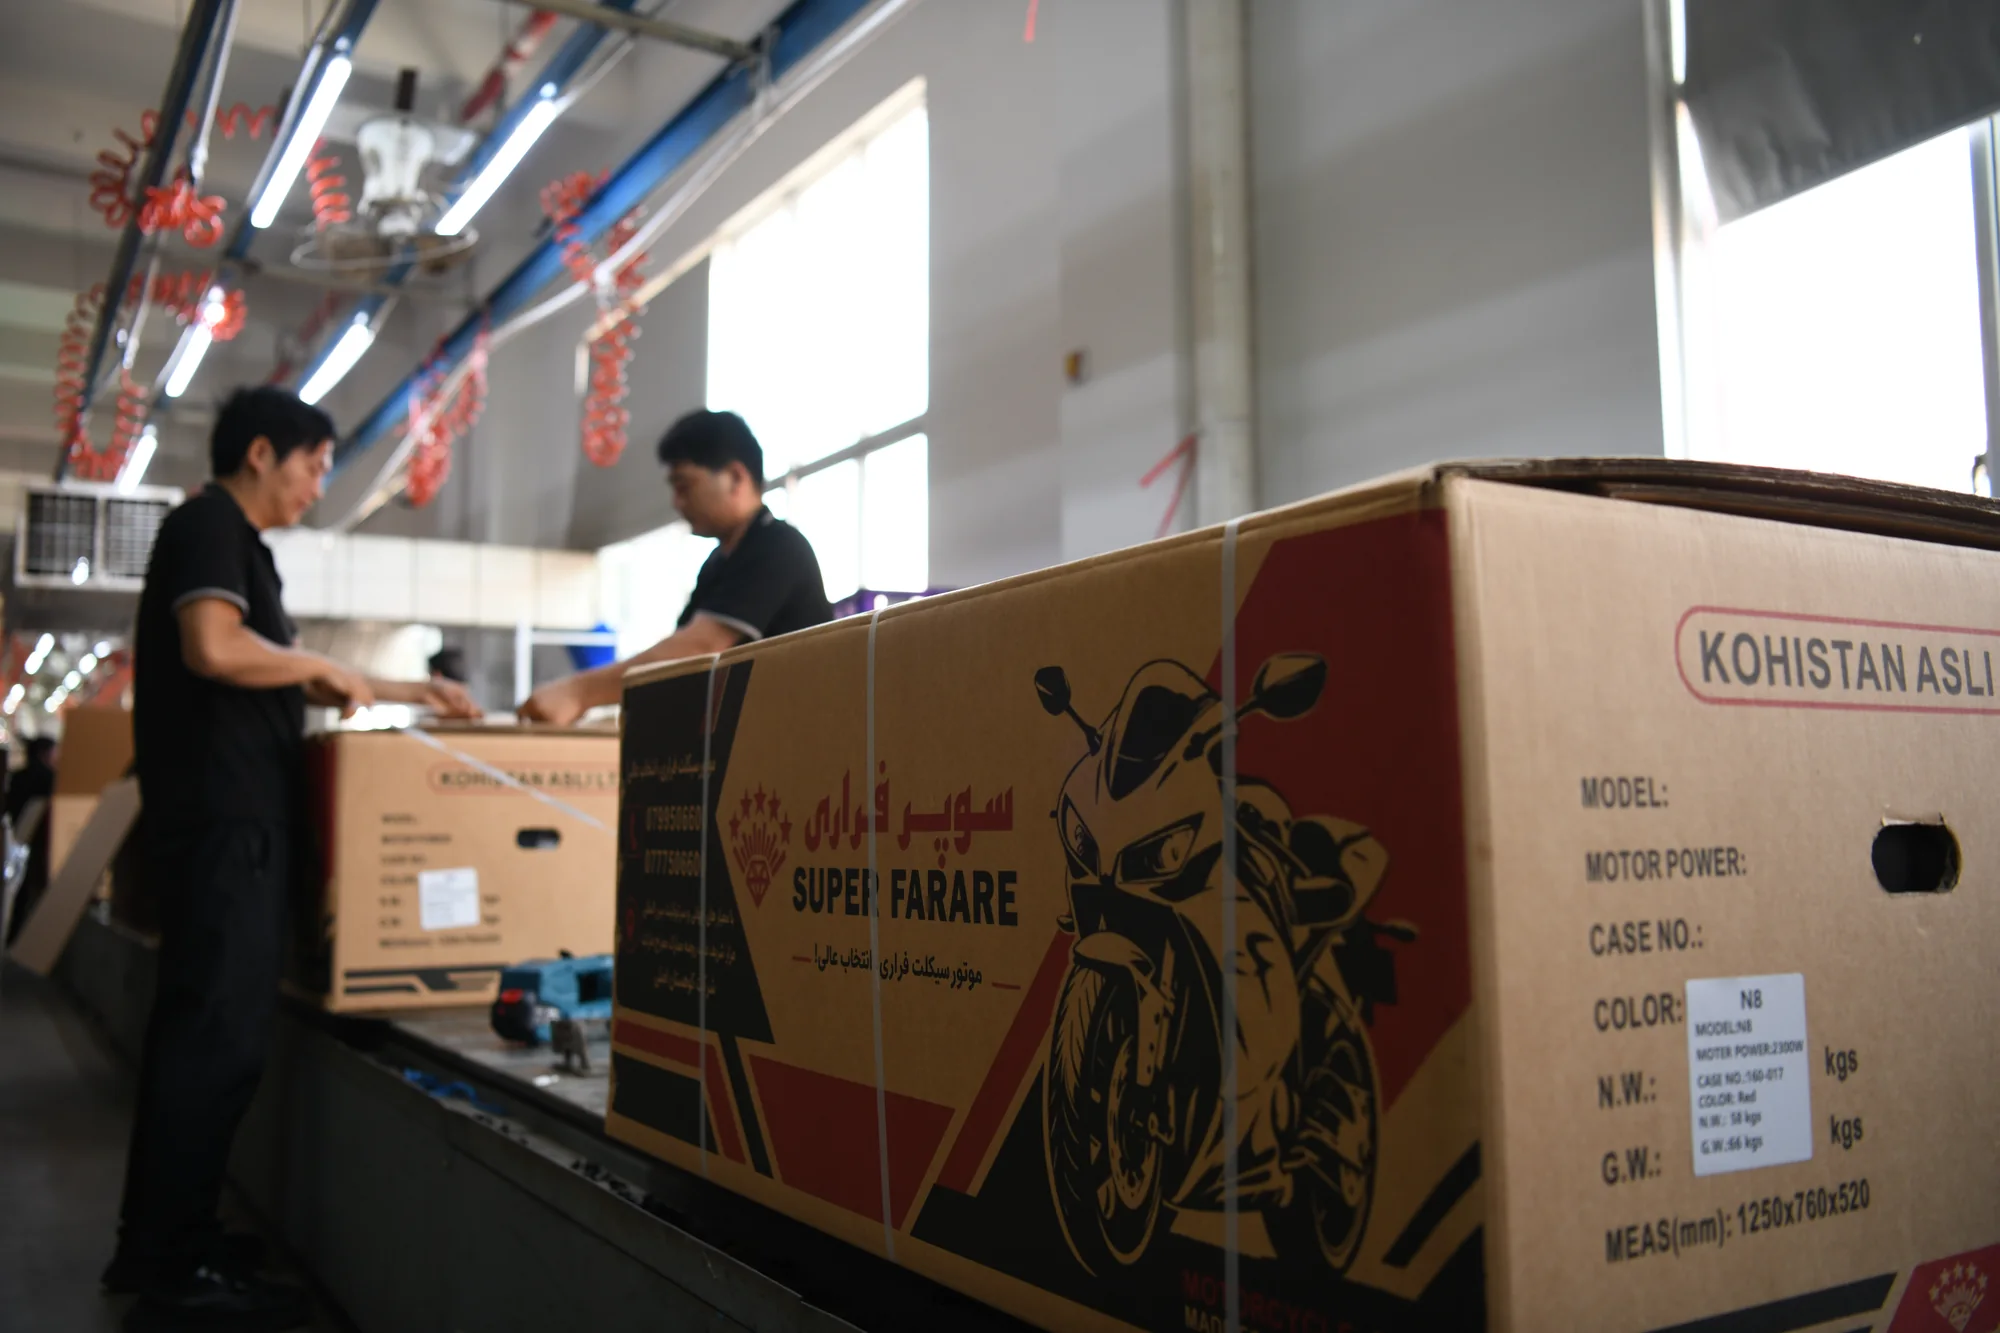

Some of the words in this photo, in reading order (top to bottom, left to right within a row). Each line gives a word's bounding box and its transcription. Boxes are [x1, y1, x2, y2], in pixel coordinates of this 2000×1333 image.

[1699, 631, 1907, 692] KOHISTAN
[1916, 646, 1995, 696] ASLI
[805, 760, 889, 853] فراری
[1581, 776, 1669, 808] MODEL:
[897, 784, 1013, 869] سوپر
[1586, 850, 1664, 883] MOTOR
[1667, 847, 1747, 878] POWER:
[891, 869, 1018, 927] FARARE
[1590, 920, 1652, 956] CASE
[1658, 917, 1703, 950] NO.:
[841, 948, 873, 973] انتخاب
[880, 952, 909, 980] فراری
[1594, 993, 1684, 1031] COLOR:
[1740, 989, 1763, 1010] N8
[1696, 1044, 1732, 1062] MOTER
[1598, 1072, 1657, 1108] N.W.:
[1825, 1046, 1858, 1081] kgs
[1697, 1073, 1722, 1089] CASE
[1738, 1090, 1757, 1104] Red
[1744, 1111, 1762, 1127] kgs
[1602, 1149, 1662, 1186] G.W.:
[1830, 1114, 1863, 1149] kgs
[1744, 1135, 1763, 1152] kgs
[1606, 1207, 1733, 1264] MEAS(mm):
[1738, 1178, 1871, 1236] 1250x760x520
